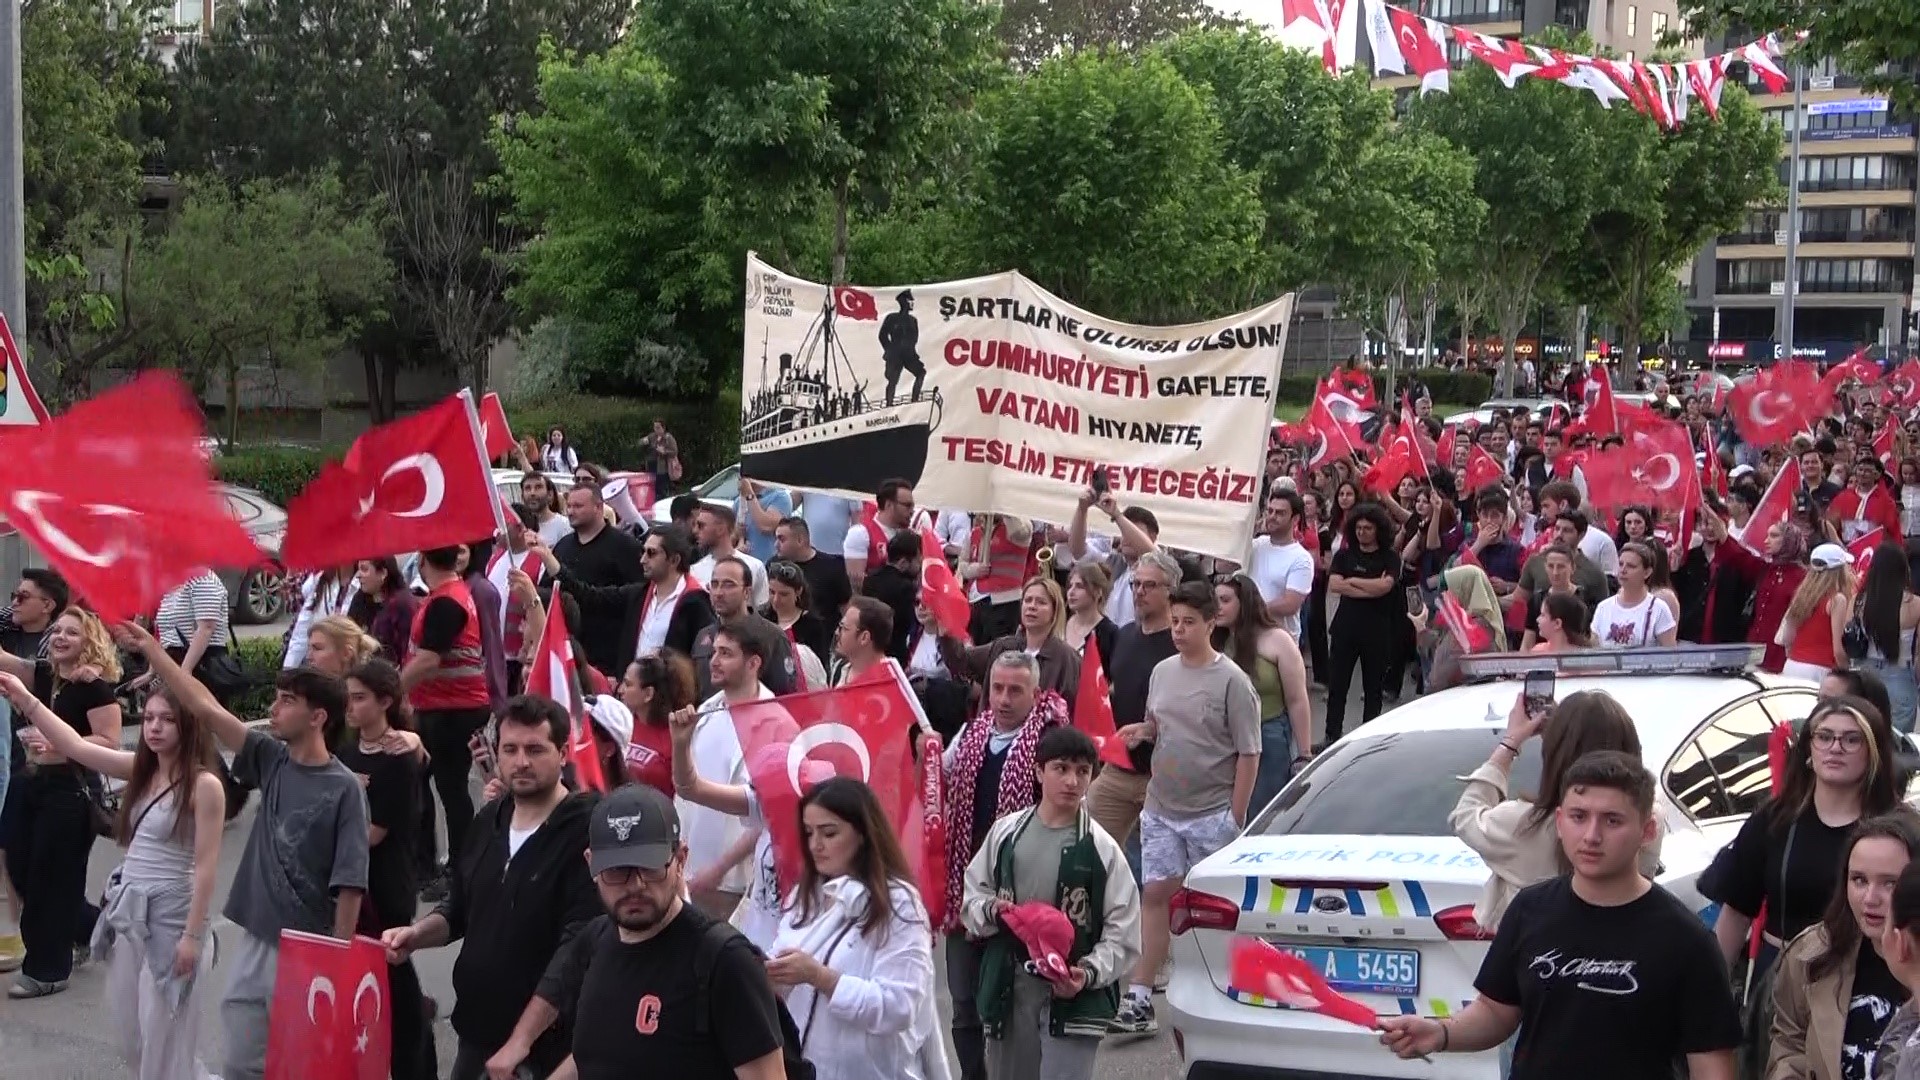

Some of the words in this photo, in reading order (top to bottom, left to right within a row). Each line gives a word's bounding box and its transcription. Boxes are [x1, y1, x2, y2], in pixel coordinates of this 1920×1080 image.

[939, 296, 1052, 329] ŞARTLAR
[1056, 312, 1082, 339] NE
[1186, 323, 1282, 351] OLSUN!
[944, 338, 1149, 399] CUMHURİYETİ
[1157, 376, 1271, 403] GAFLETE,
[976, 387, 1079, 435] VATANI
[1088, 414, 1203, 450] HIYANETE,
[941, 436, 1046, 475] TESLİM
[1325, 951, 1338, 978] A
[1357, 952, 1413, 982] 5455
